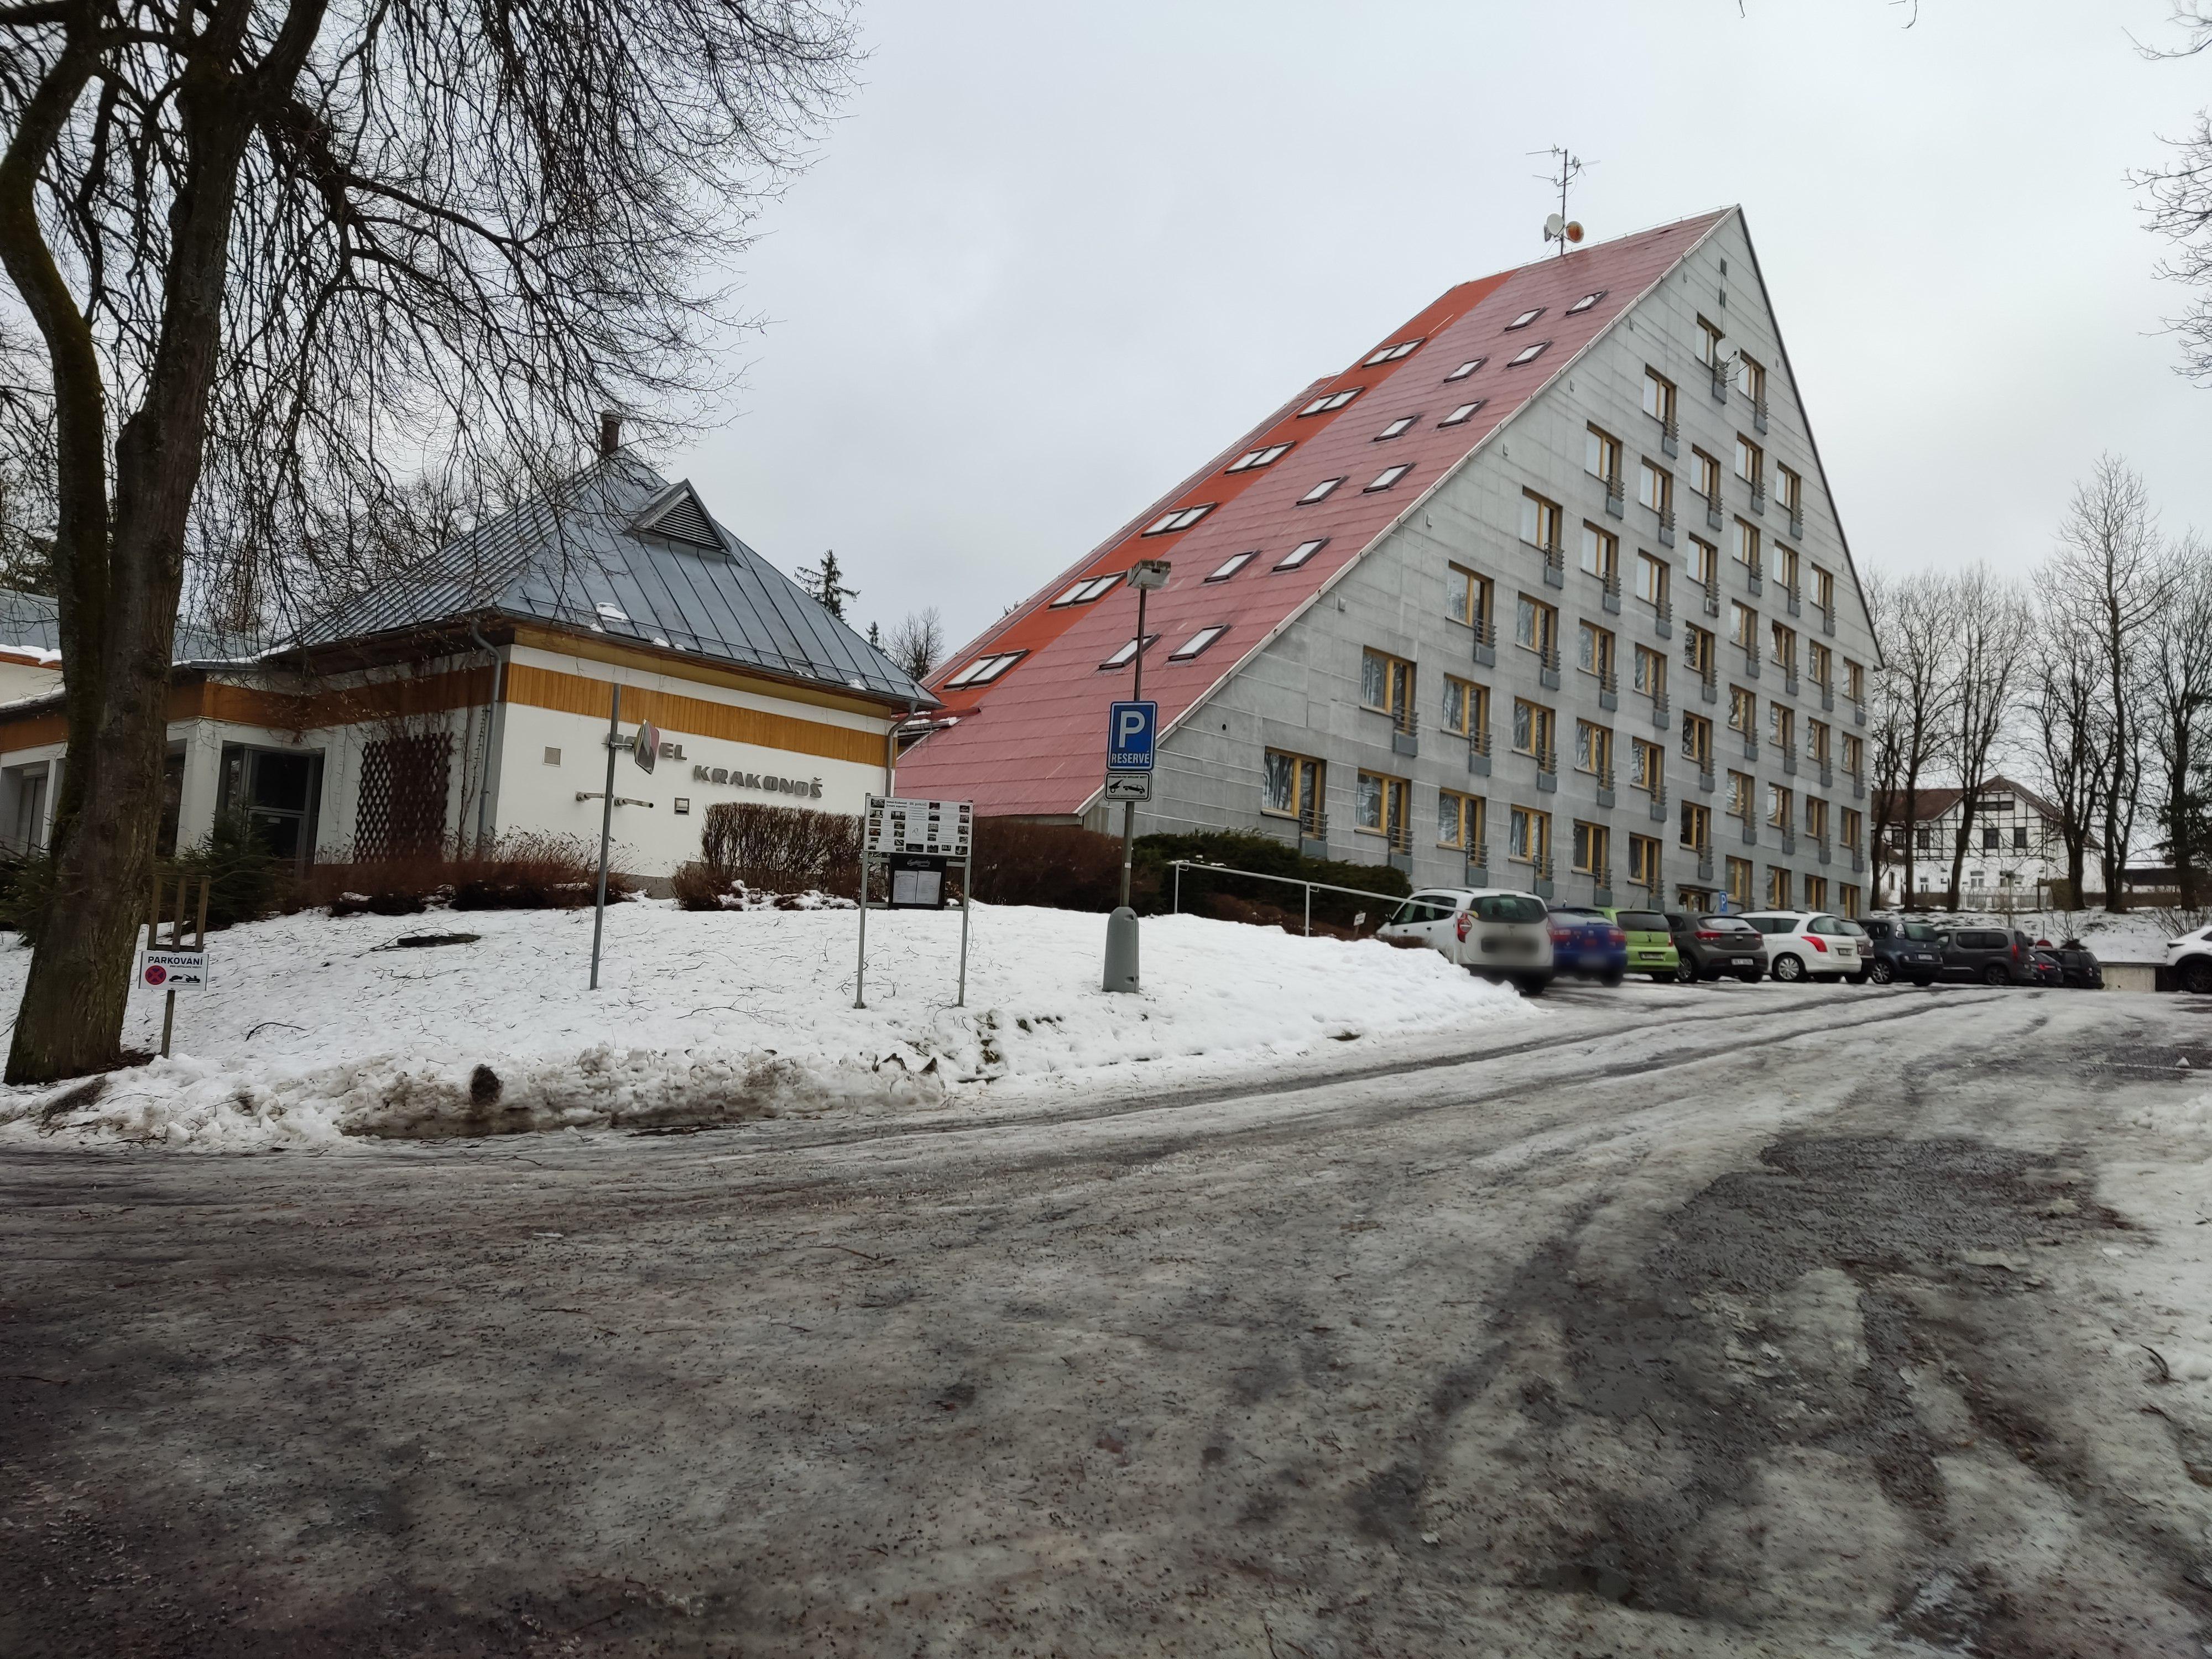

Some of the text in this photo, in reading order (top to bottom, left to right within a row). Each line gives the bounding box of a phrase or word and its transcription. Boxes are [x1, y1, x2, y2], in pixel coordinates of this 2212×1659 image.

[1118, 711, 1145, 748] P
[1111, 751, 1150, 764] RESERVÉ
[694, 765, 823, 798] KRAKONOŠ
[1721, 895, 1726, 908] P
[148, 956, 203, 966] PARKOVÁNÍ
